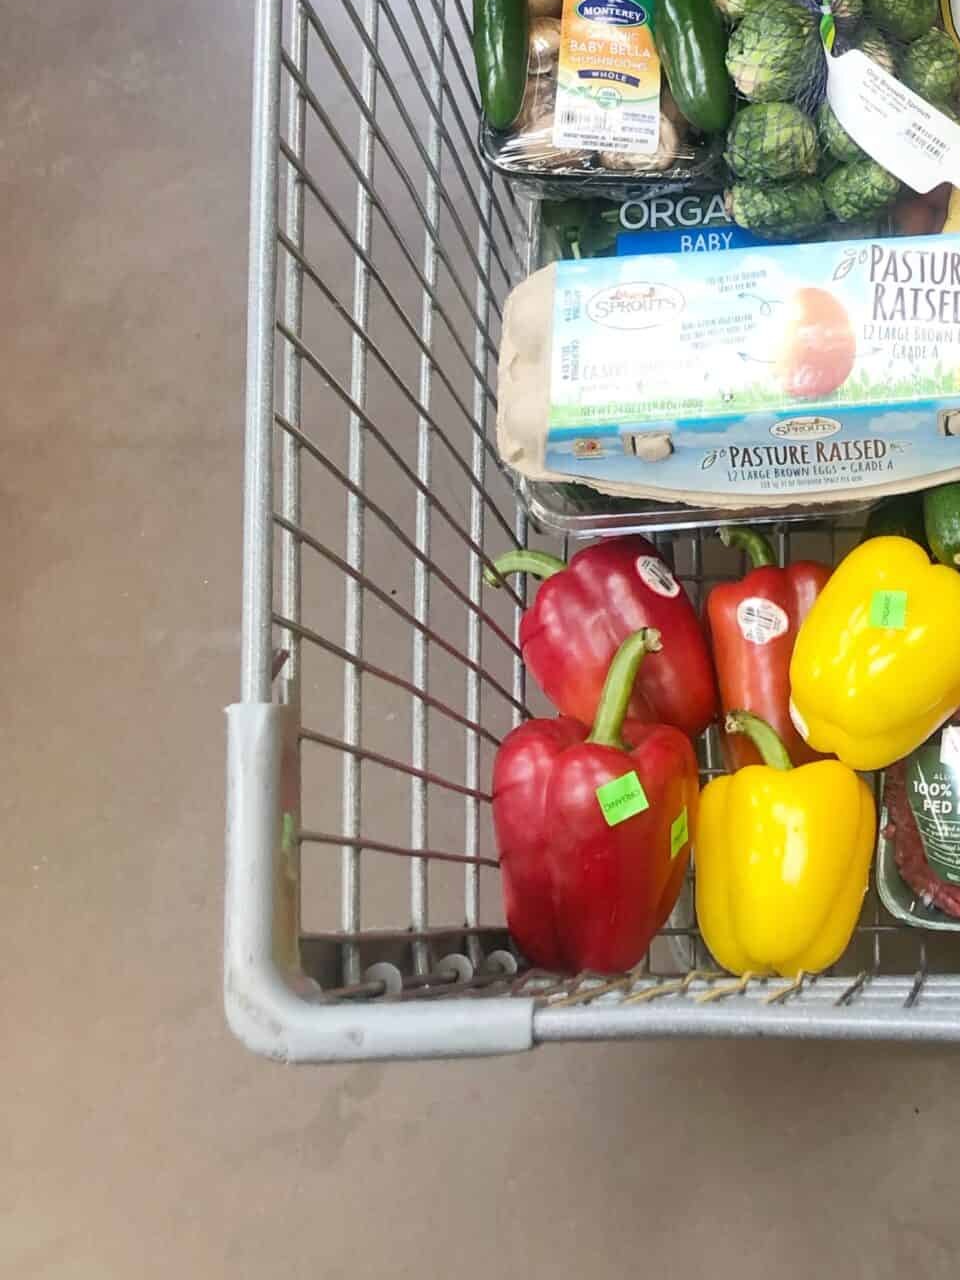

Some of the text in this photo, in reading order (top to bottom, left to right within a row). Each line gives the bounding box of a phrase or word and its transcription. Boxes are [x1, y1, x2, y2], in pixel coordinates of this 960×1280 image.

[583, 6, 642, 21] MONTEREY
[570, 40, 651, 58] BABY BELLA
[592, 71, 627, 83] WHOLE
[619, 194, 732, 230] ORGA
[681, 232, 733, 253] BABY
[594, 296, 677, 319] SPROUTS
[878, 325, 910, 342] LARGE
[914, 327, 953, 344] BROWN
[892, 343, 939, 361] GRADE A
[775, 422, 836, 437] SPROUTS
[729, 439, 887, 468] PASTURE RAISED
[742, 470, 771, 481] LARGE
[774, 467, 809, 479] BROWN
[813, 465, 838, 476] EGGS
[850, 461, 882, 473] GRADE
[887, 460, 894, 471] A
[913, 781, 952, 797] 100%
